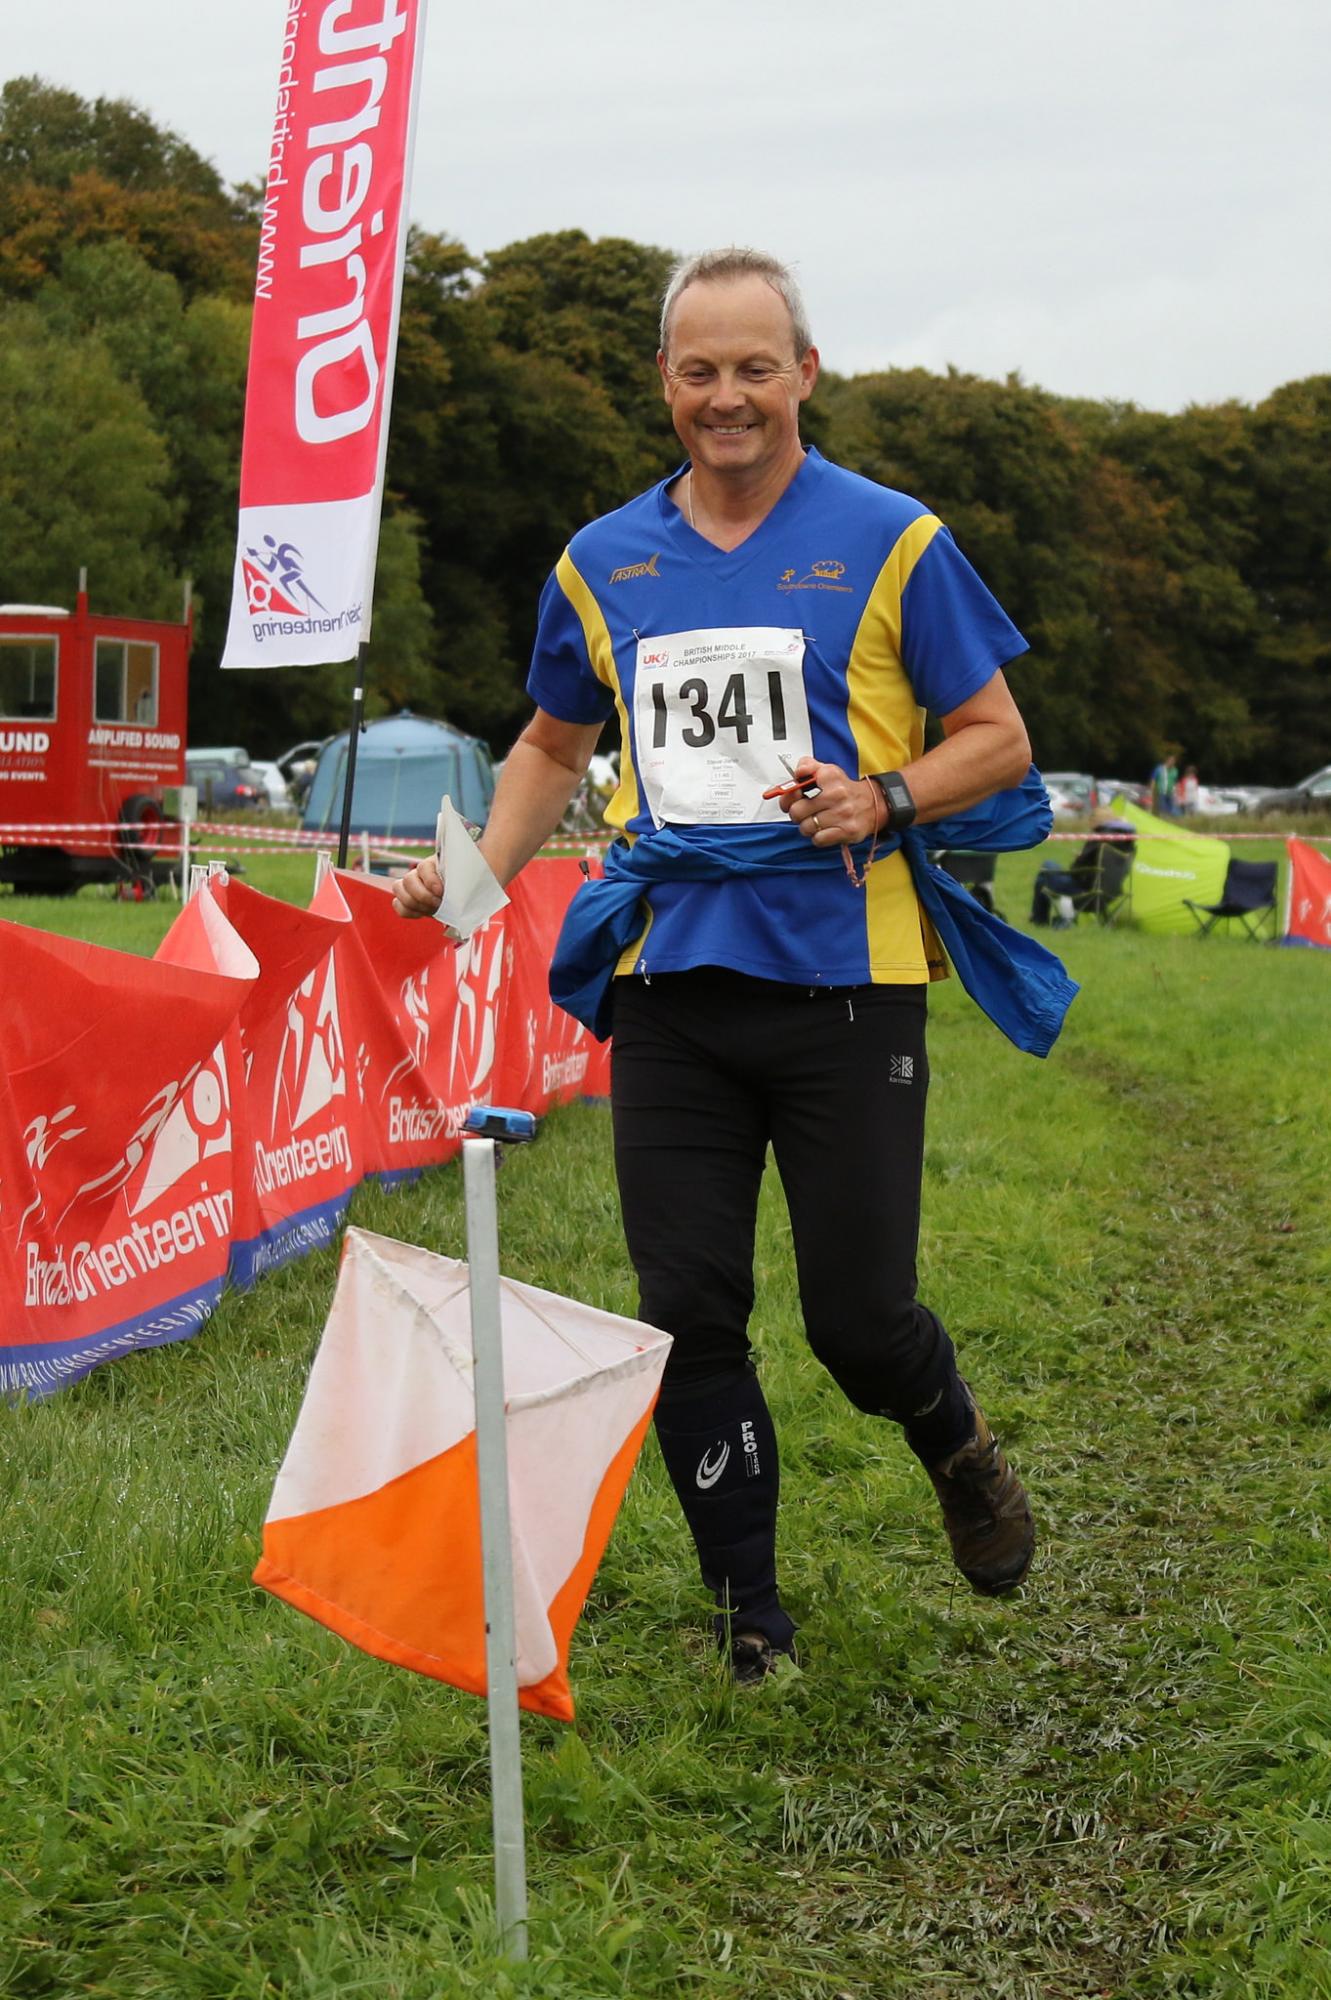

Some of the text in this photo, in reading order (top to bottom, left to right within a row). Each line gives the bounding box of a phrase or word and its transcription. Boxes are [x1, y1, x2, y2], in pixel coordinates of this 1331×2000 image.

[672, 652, 736, 668] CHAMPIONSHIPS
[738, 651, 756, 659] 2017
[683, 644, 746, 657] BRITISH MIDDLE
[651, 671, 788, 749] 1341
[88, 729, 181, 751] AMPLIFIED SOUND
[741, 1421, 758, 1453] PRO
